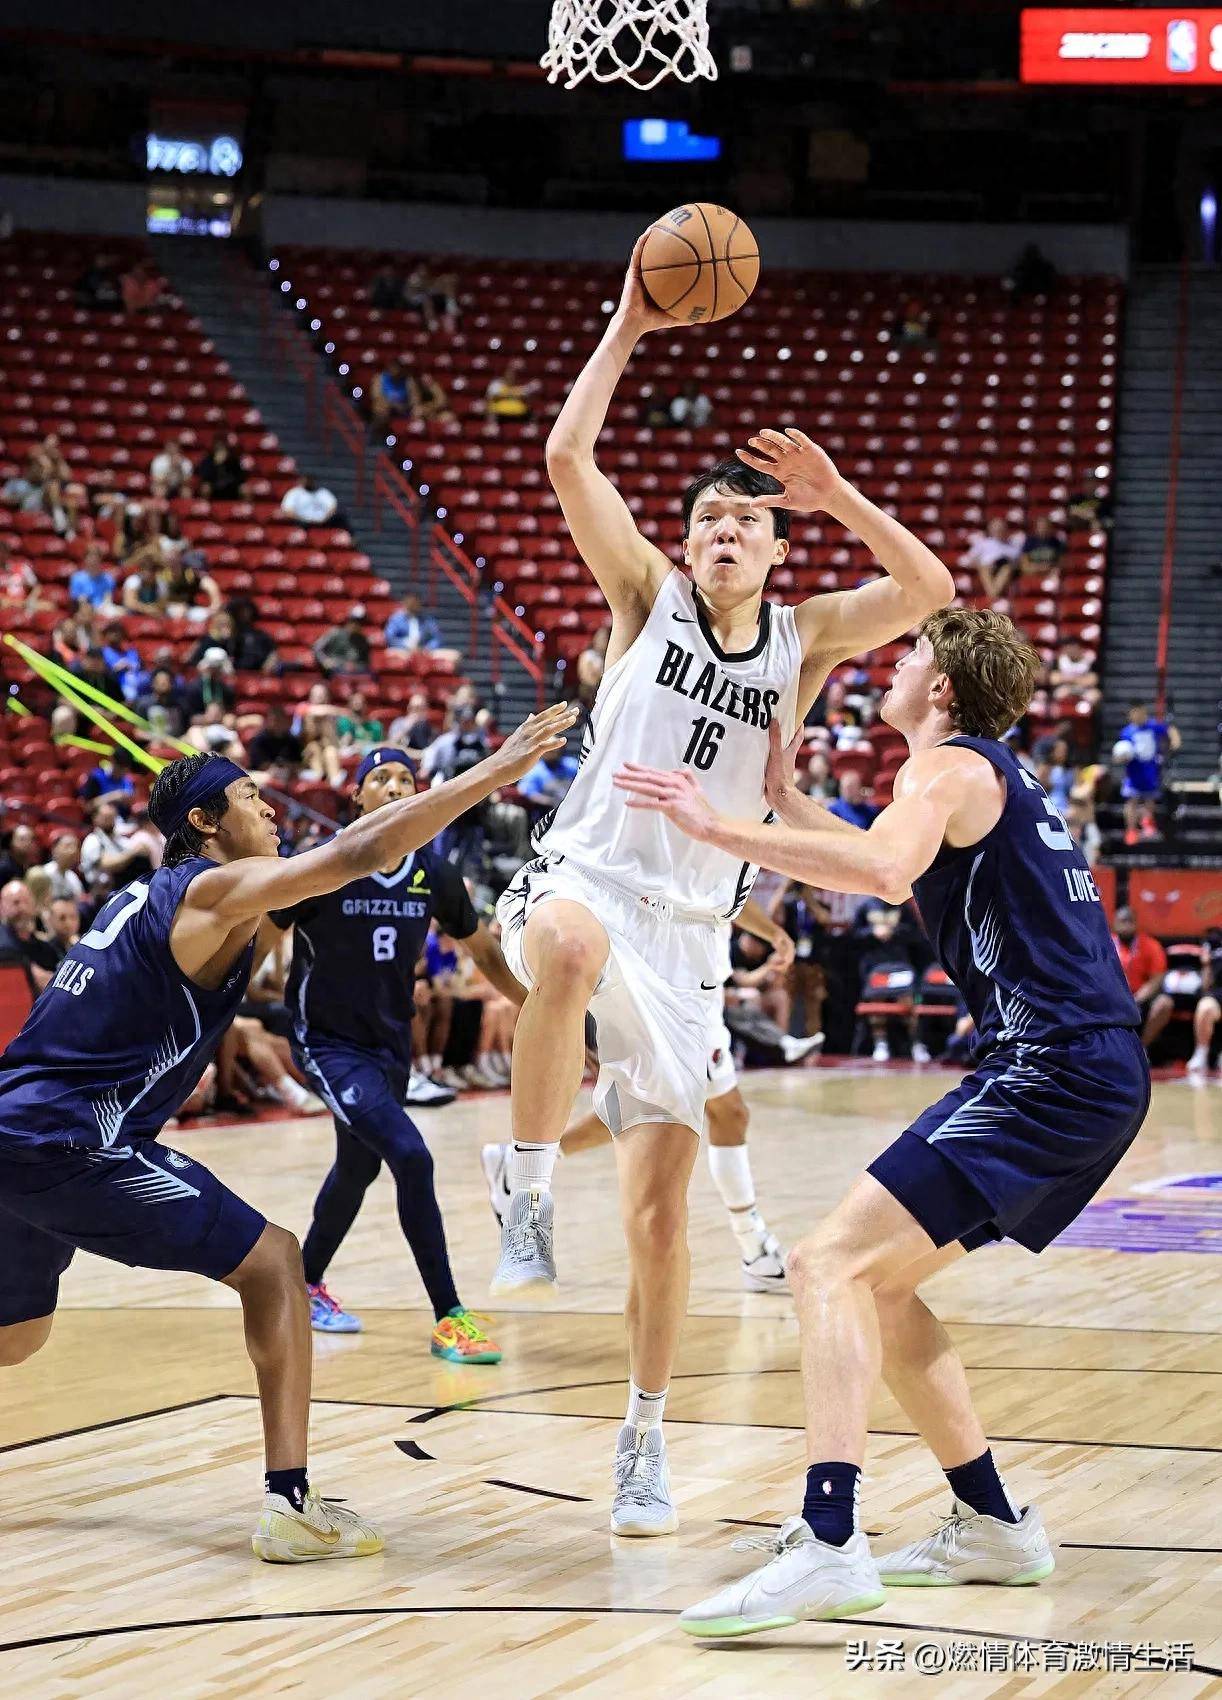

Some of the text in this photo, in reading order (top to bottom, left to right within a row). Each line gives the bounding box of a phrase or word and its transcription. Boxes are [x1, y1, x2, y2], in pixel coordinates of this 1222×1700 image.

[655, 639, 780, 731] BLAZERS
[682, 715, 726, 771] 16
[1063, 868, 1100, 902] LOVE
[342, 898, 428, 918] GRIZZLIES
[372, 925, 398, 962] 8
